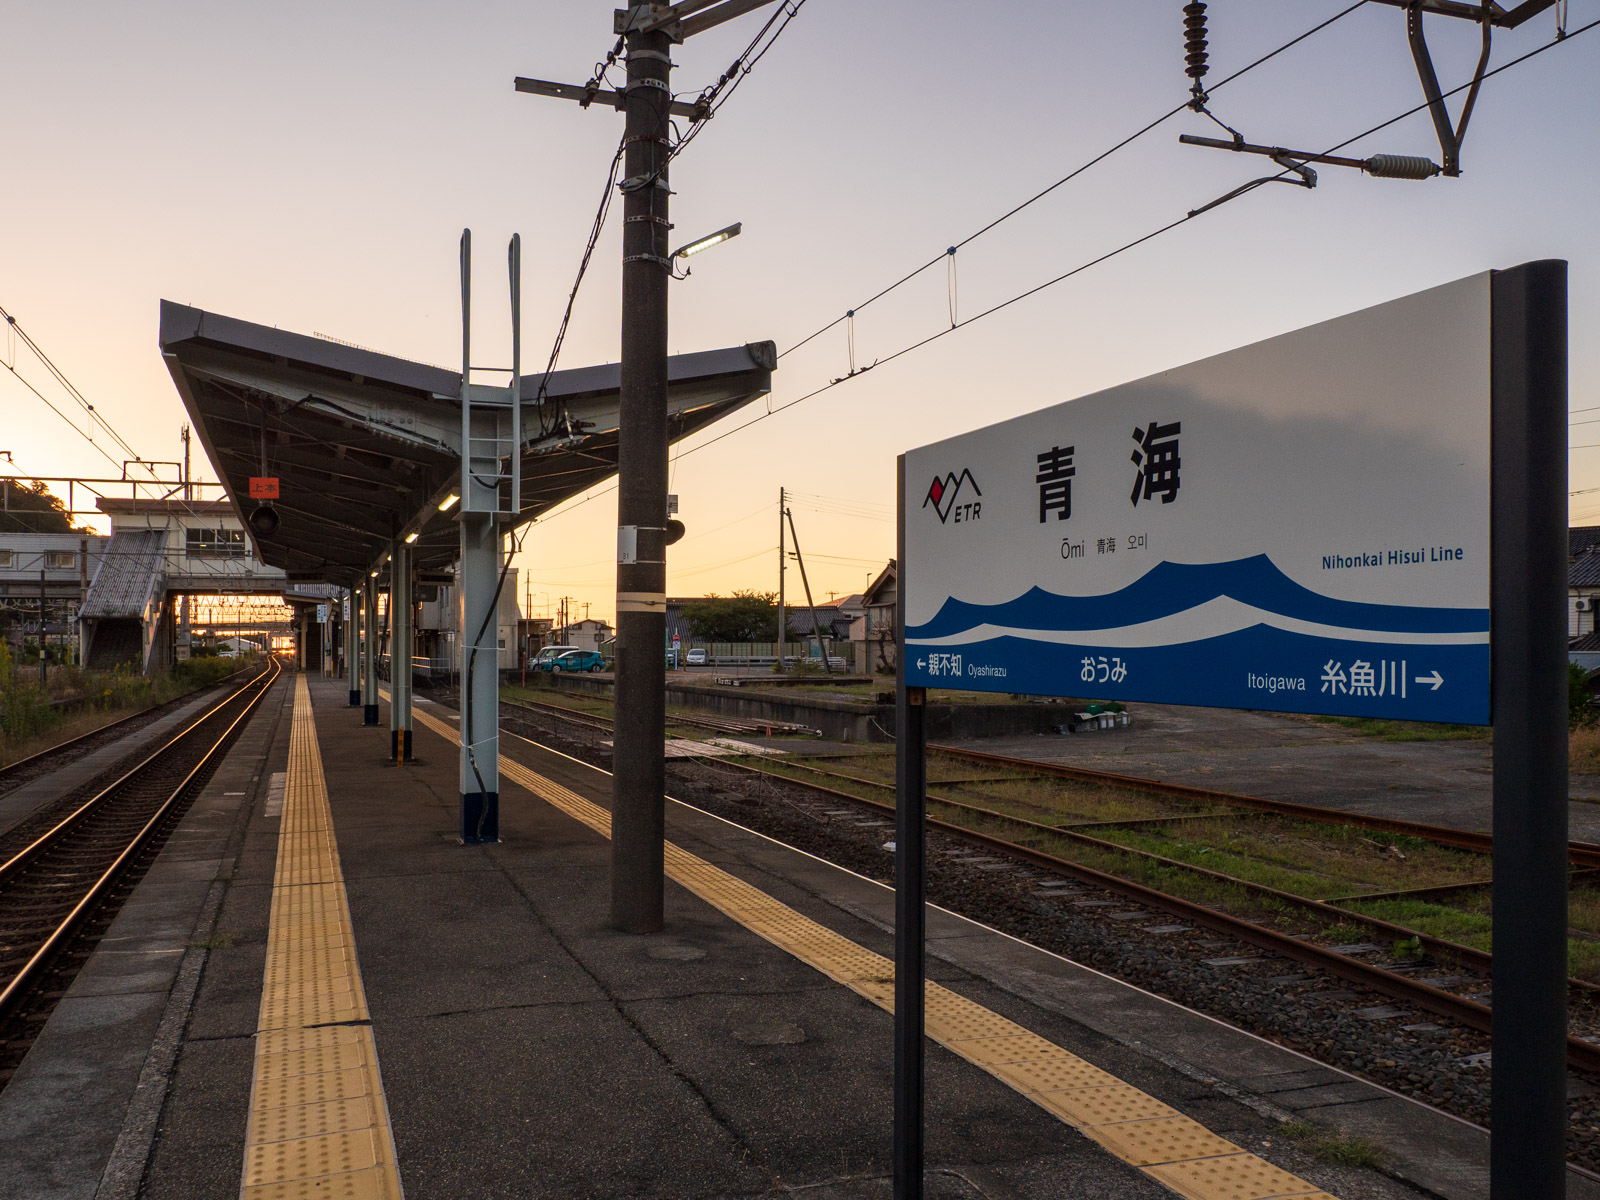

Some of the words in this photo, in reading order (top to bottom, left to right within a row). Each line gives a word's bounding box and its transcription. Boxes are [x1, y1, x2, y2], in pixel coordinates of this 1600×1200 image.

[1035, 421, 1181, 524] 青海
[954, 502, 982, 523] ETR
[1060, 538, 1085, 559] Ōmi
[1096, 537, 1116, 554] 青海
[1127, 533, 1148, 550] 오미
[1322, 552, 1383, 570] Nihonkai
[1388, 548, 1425, 565] Hisui
[1431, 547, 1464, 562] Line
[928, 653, 962, 677] 親不知
[967, 664, 1007, 678] Oyashirazu
[1080, 656, 1127, 683] おうみ
[1248, 672, 1306, 694] Itoigawa
[1320, 659, 1407, 699] 糸魚川
